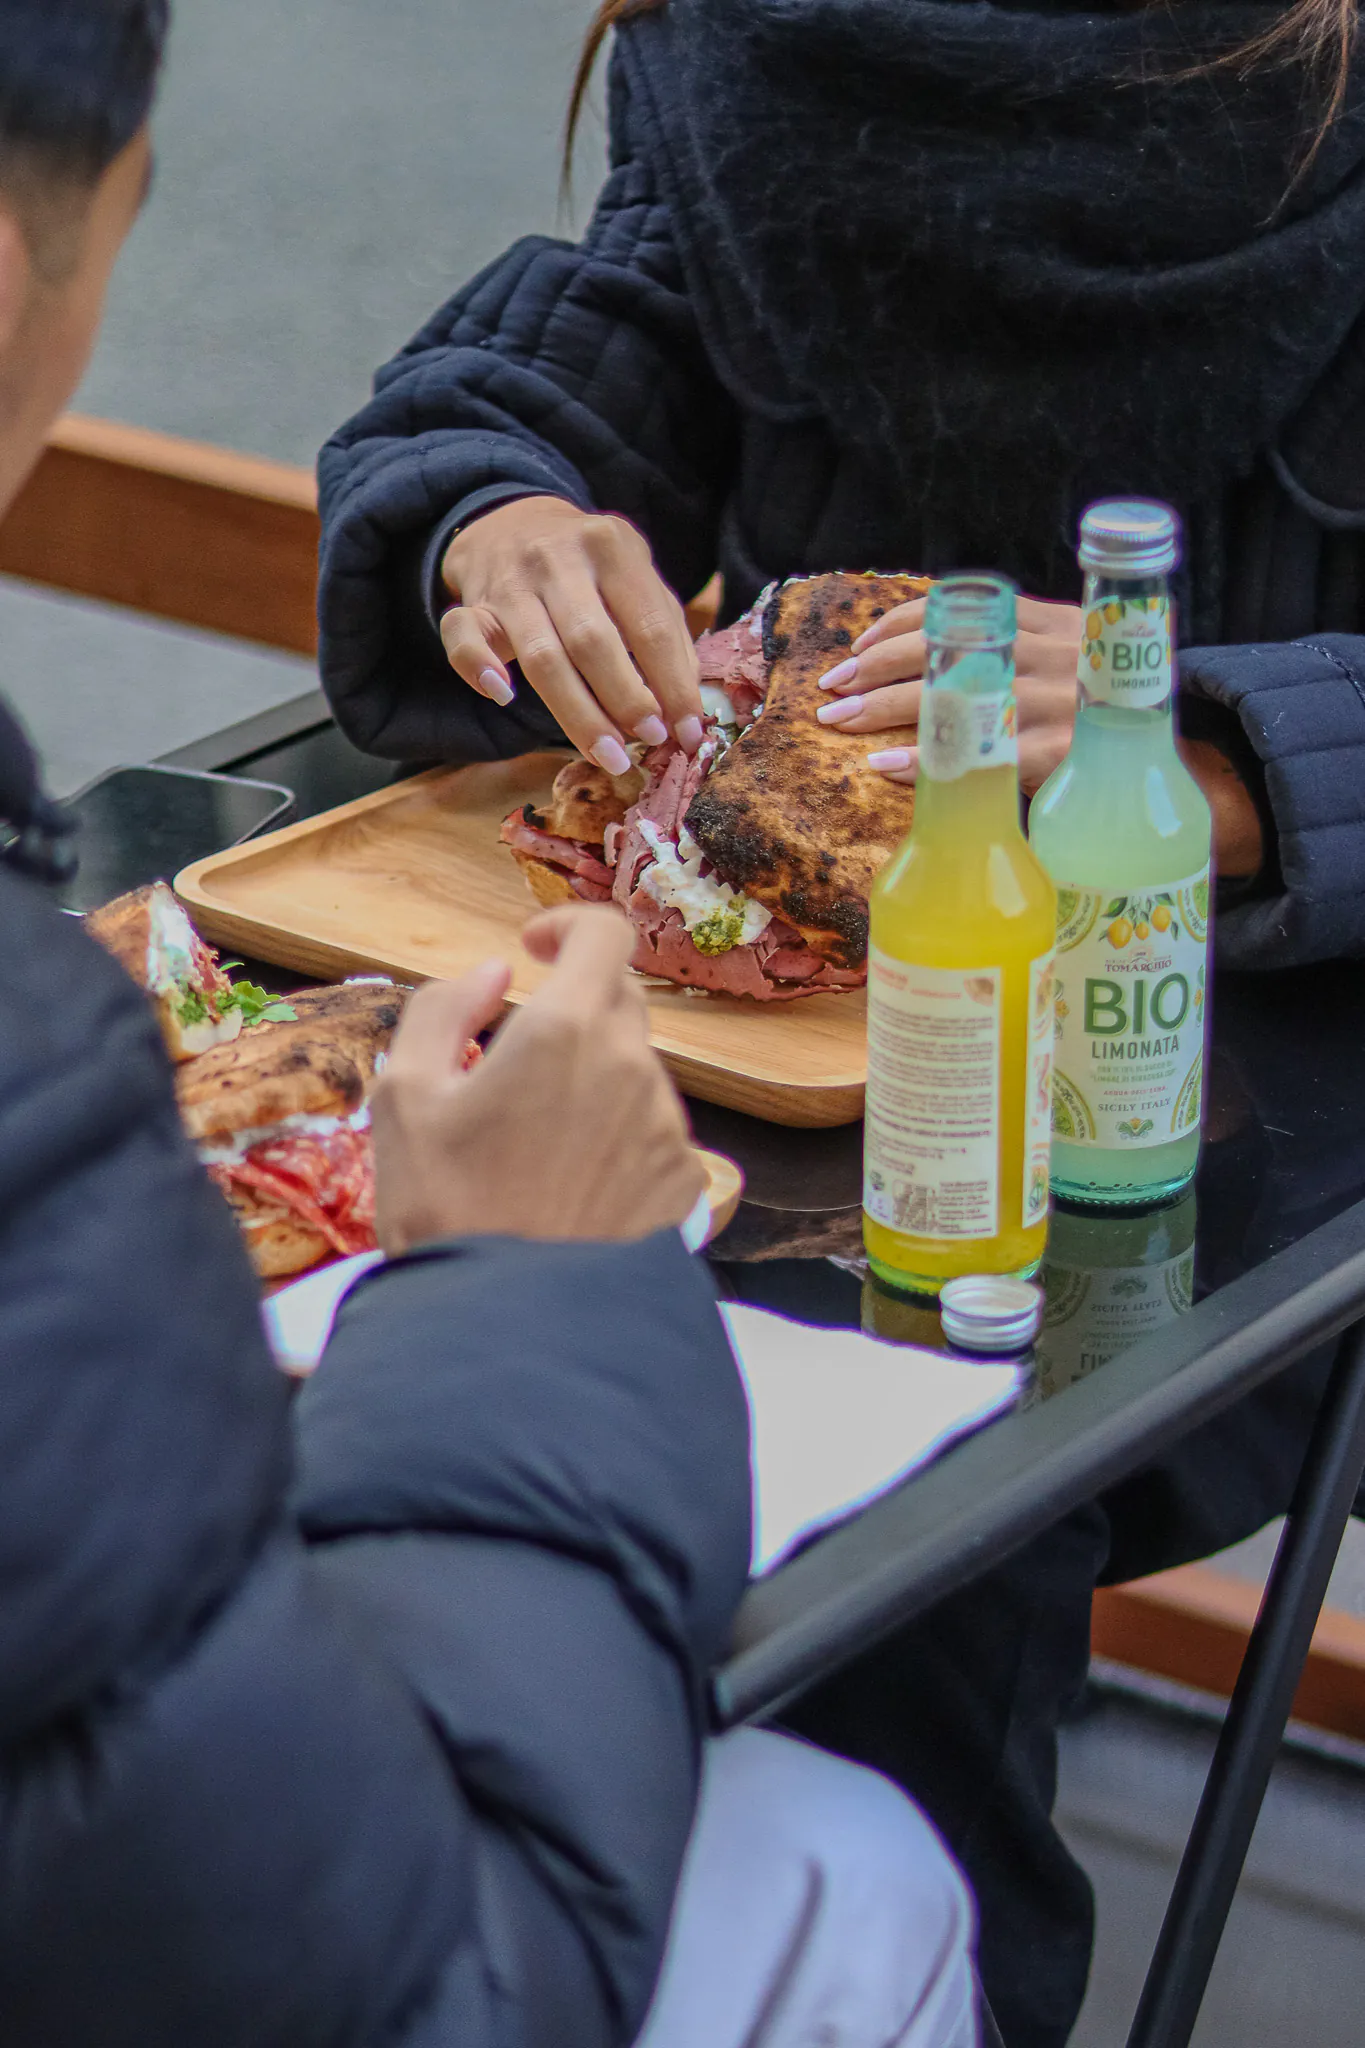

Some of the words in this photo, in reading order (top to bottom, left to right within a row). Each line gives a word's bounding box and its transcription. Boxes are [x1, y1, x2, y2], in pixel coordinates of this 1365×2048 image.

[1112, 641, 1162, 671] BIO
[1111, 675, 1160, 689] LIMONATA
[1083, 972, 1189, 1035] BIO
[1092, 1034, 1180, 1060] LIMONATA
[1098, 1103, 1136, 1112] SICILY
[1141, 1096, 1172, 1110] ITALY
